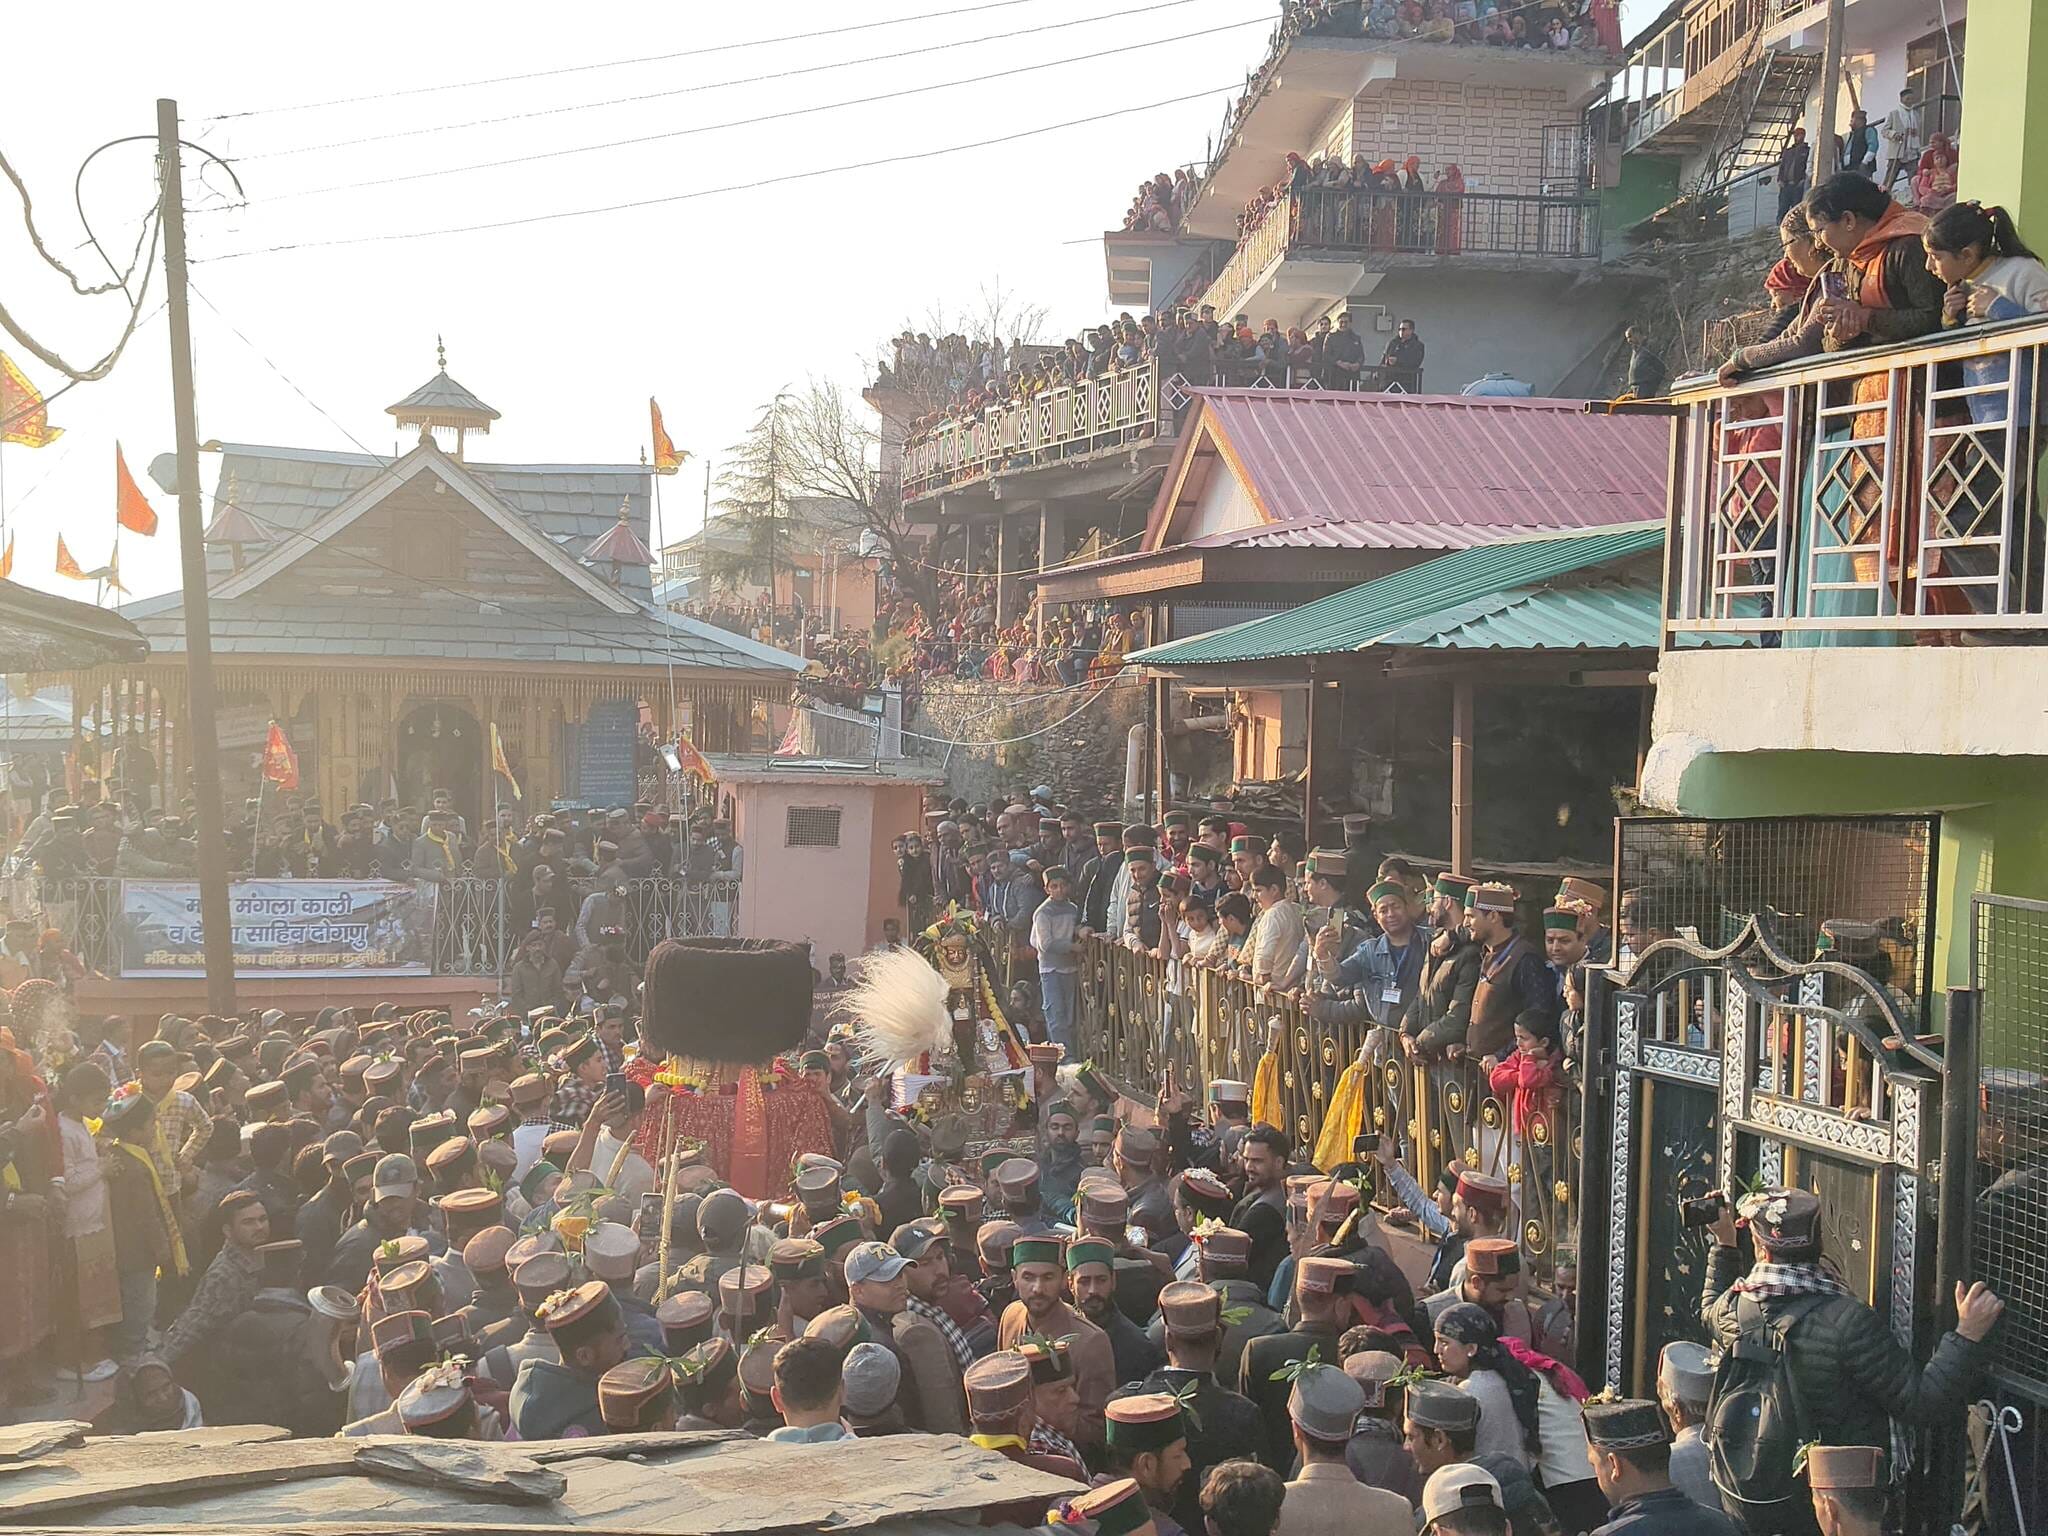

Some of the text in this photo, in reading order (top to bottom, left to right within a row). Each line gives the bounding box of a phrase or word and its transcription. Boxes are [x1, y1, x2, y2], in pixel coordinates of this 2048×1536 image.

[235, 892, 296, 914] मंगला
[301, 891, 353, 914] काली
[309, 918, 368, 950] दोगणु
[258, 950, 297, 965] हार्दिक
[298, 952, 339, 965] स्वागत
